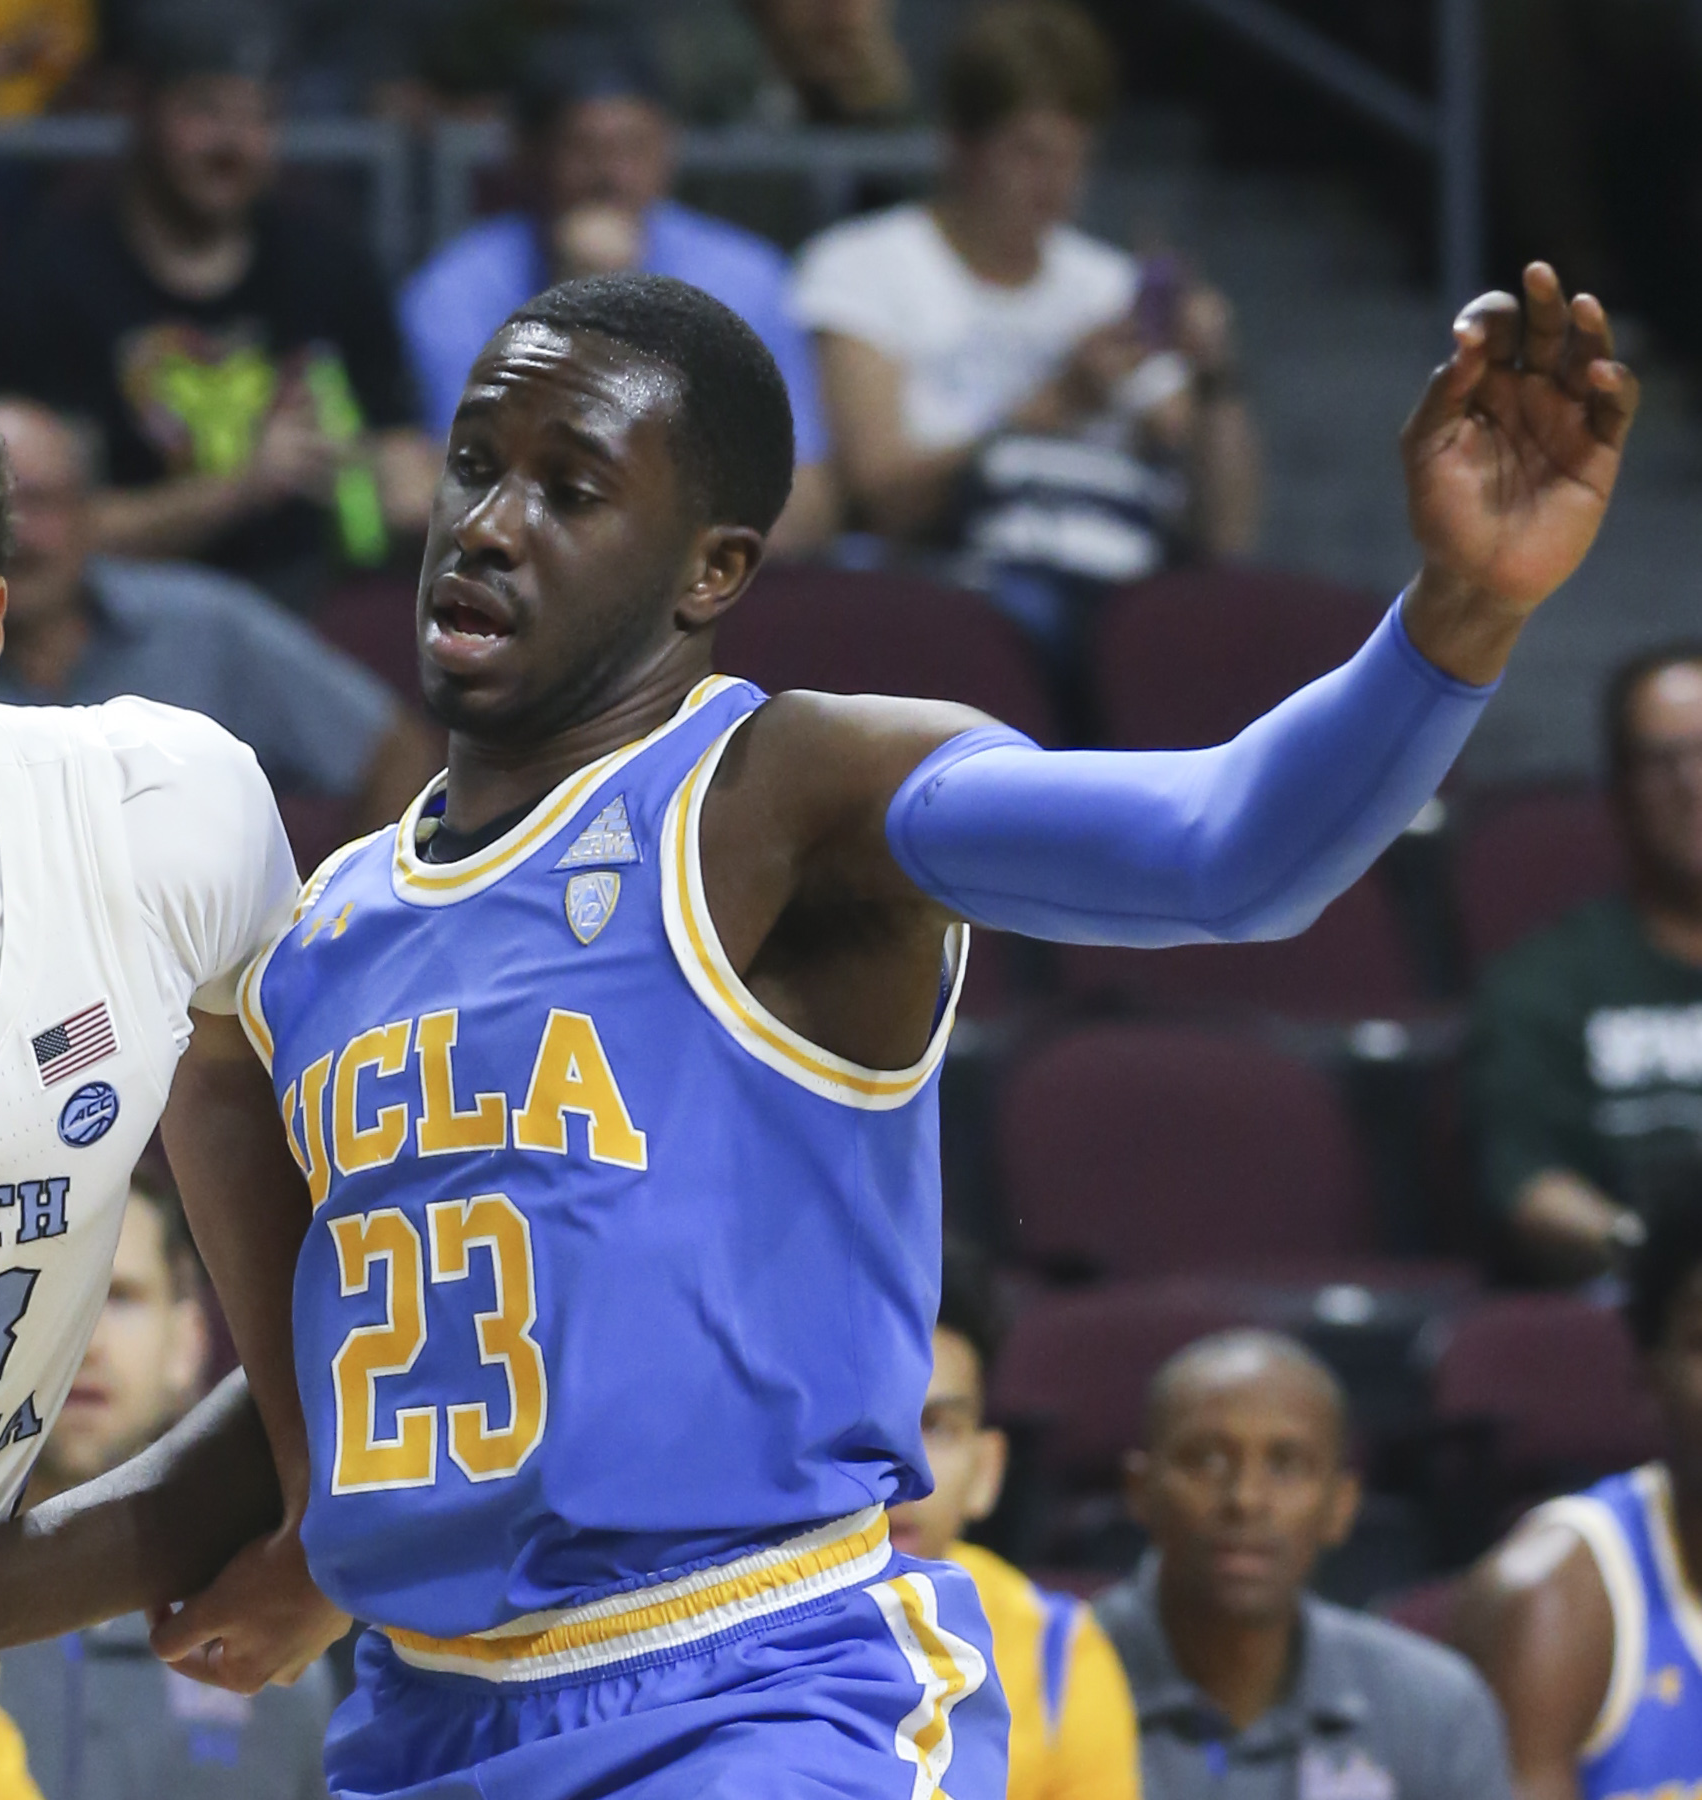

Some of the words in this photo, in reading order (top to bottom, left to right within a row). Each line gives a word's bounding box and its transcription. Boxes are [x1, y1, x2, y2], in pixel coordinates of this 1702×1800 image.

[69, 1094, 112, 1126] ACC
[282, 1007, 648, 1219] UCLA
[326, 1192, 548, 1497] 23
